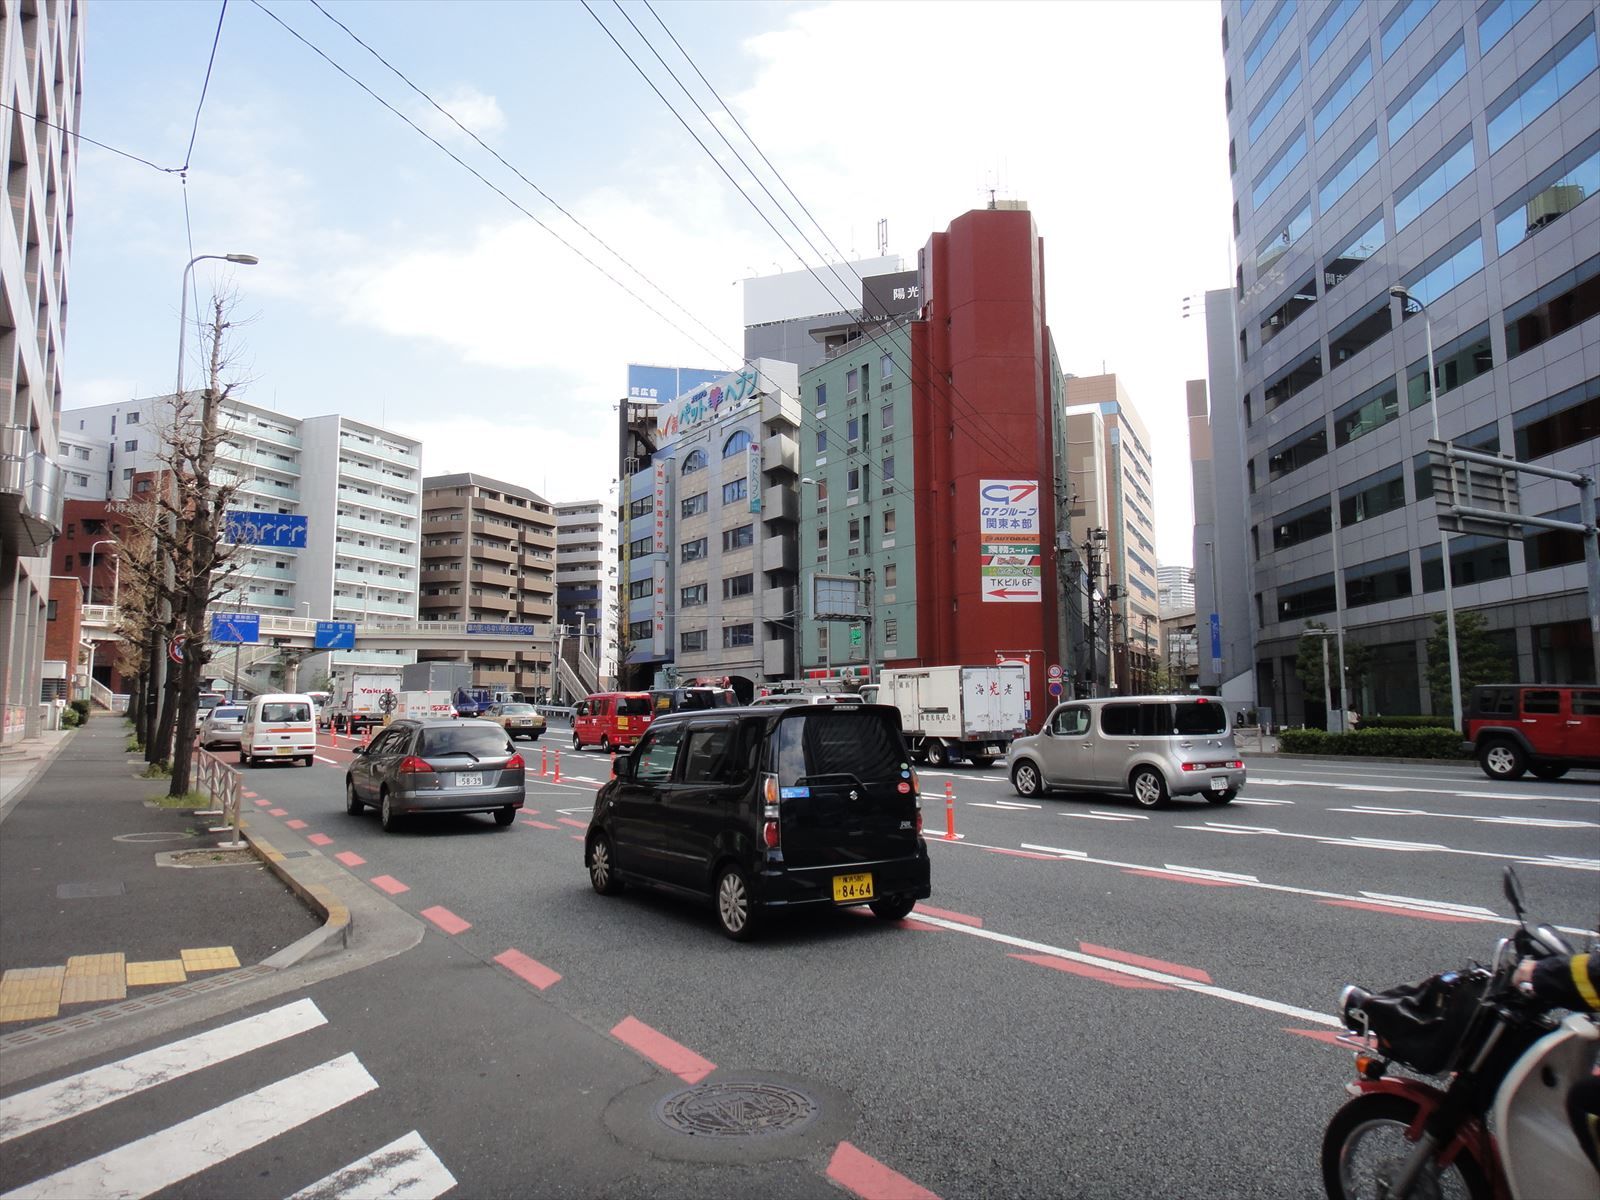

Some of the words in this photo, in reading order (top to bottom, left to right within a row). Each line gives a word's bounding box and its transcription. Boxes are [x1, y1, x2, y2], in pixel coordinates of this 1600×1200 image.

[893, 286, 919, 300] 陽光
[982, 507, 1037, 516] G7グループ
[986, 518, 1032, 529] 関東本部
[988, 545, 1034, 554] 業務スーパー
[990, 579, 1020, 587] TKビル
[1022, 579, 1032, 587] 6F
[843, 882, 871, 898] 84-64
